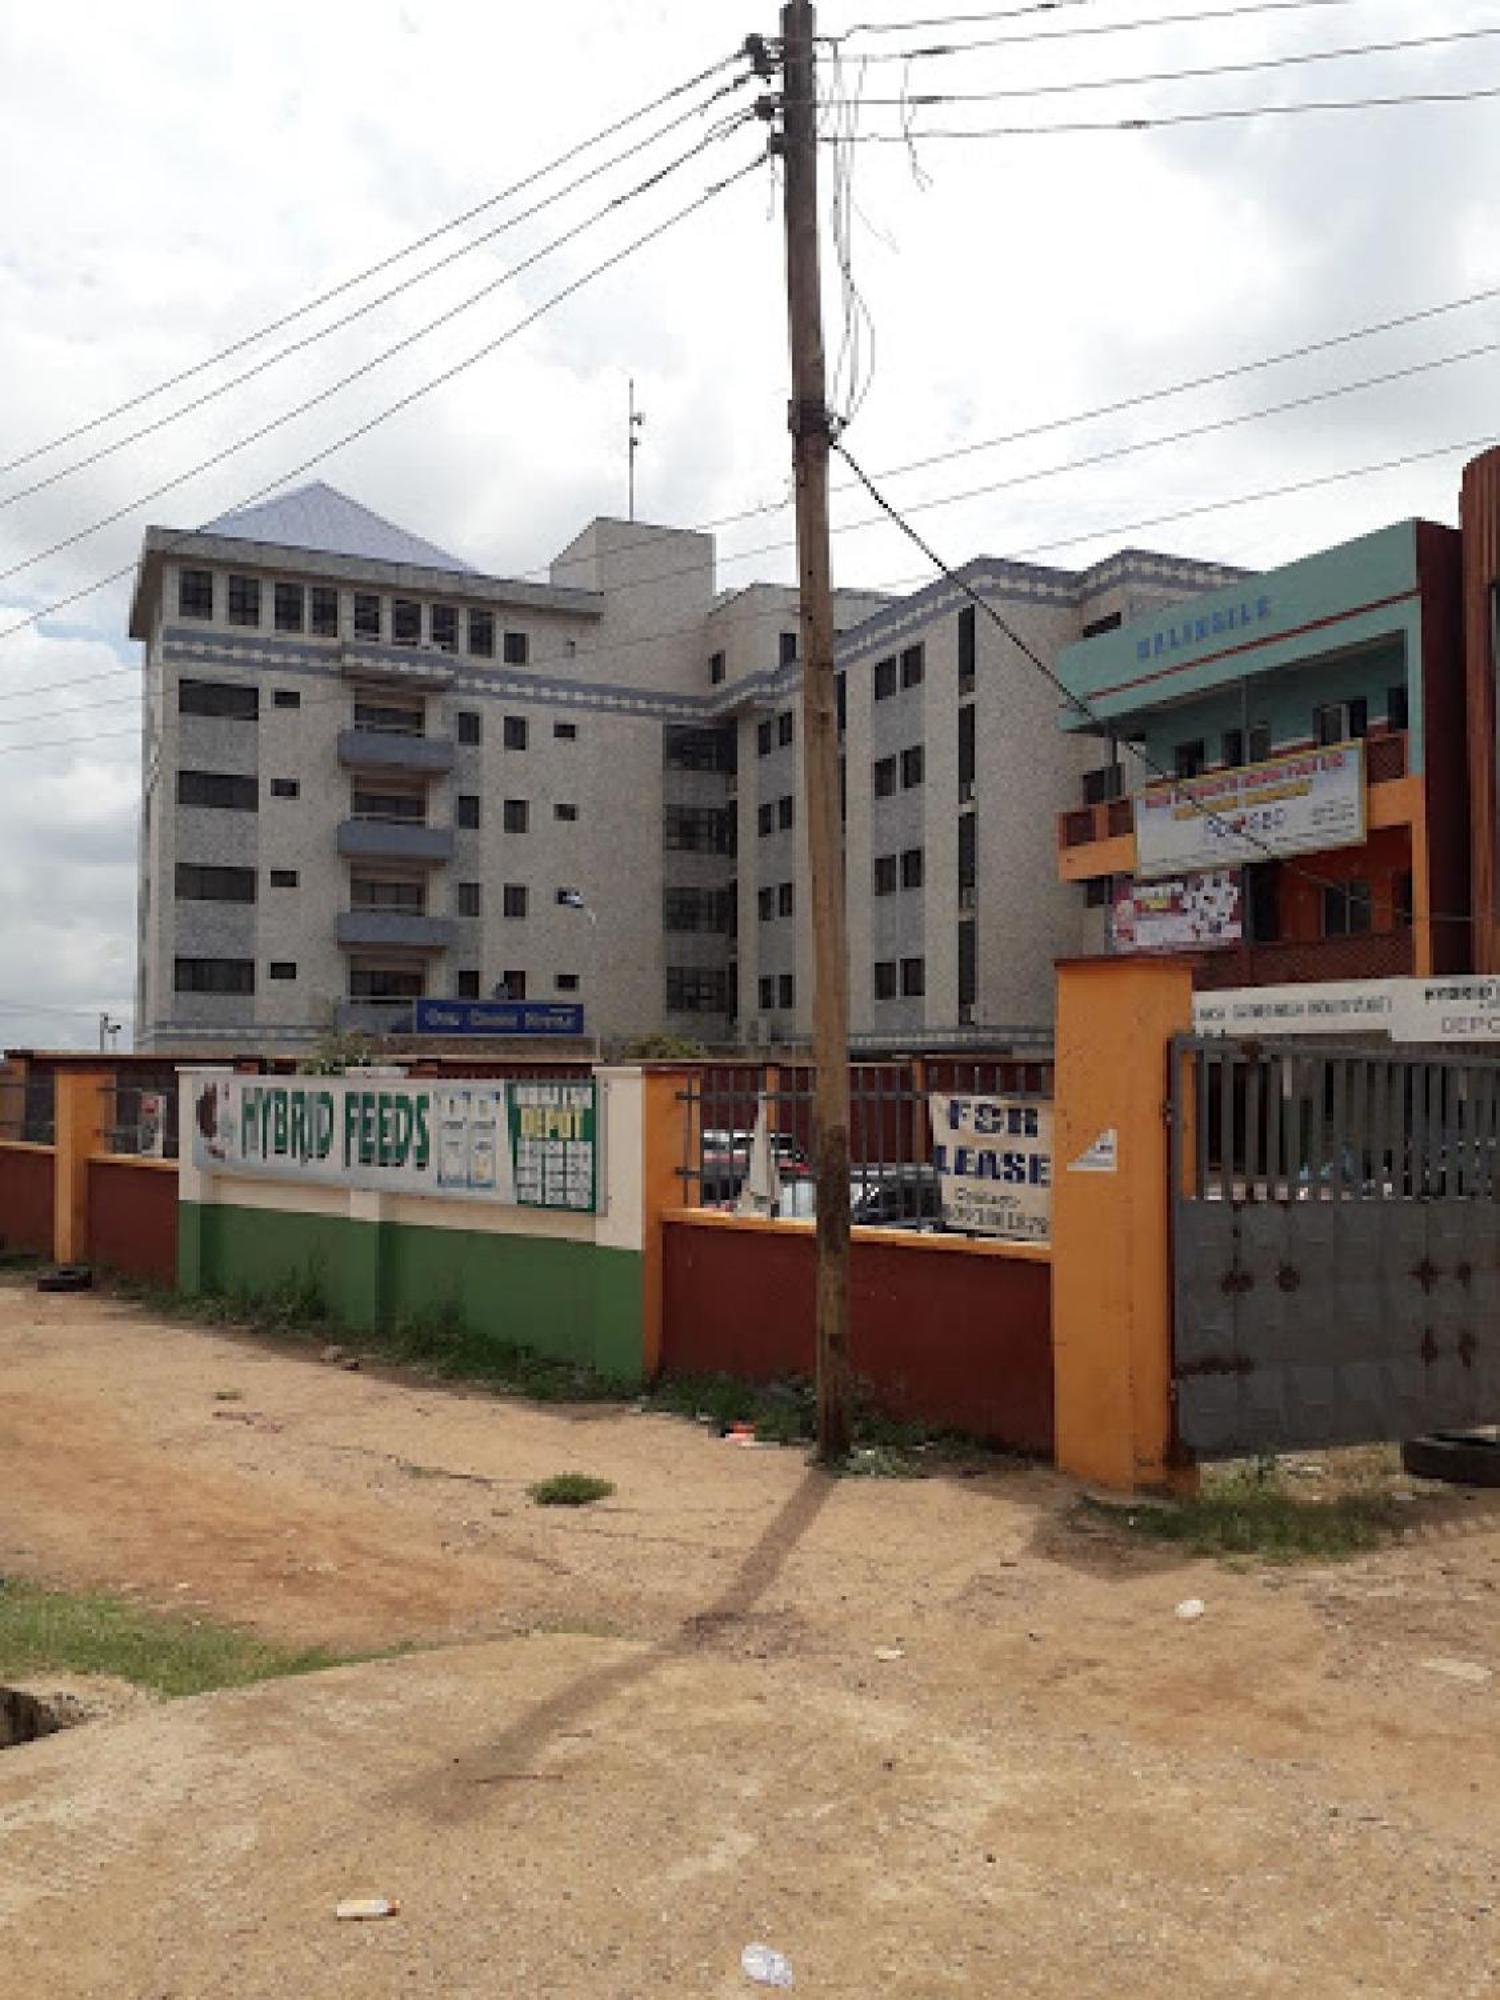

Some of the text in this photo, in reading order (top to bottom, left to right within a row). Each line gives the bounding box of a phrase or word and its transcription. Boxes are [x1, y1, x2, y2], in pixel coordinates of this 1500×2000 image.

[241, 1086, 334, 1162] HYBRID
[344, 1091, 430, 1171] FEEDS
[949, 1099, 1039, 1137] FOR
[934, 1144, 1051, 1188] LEASE
